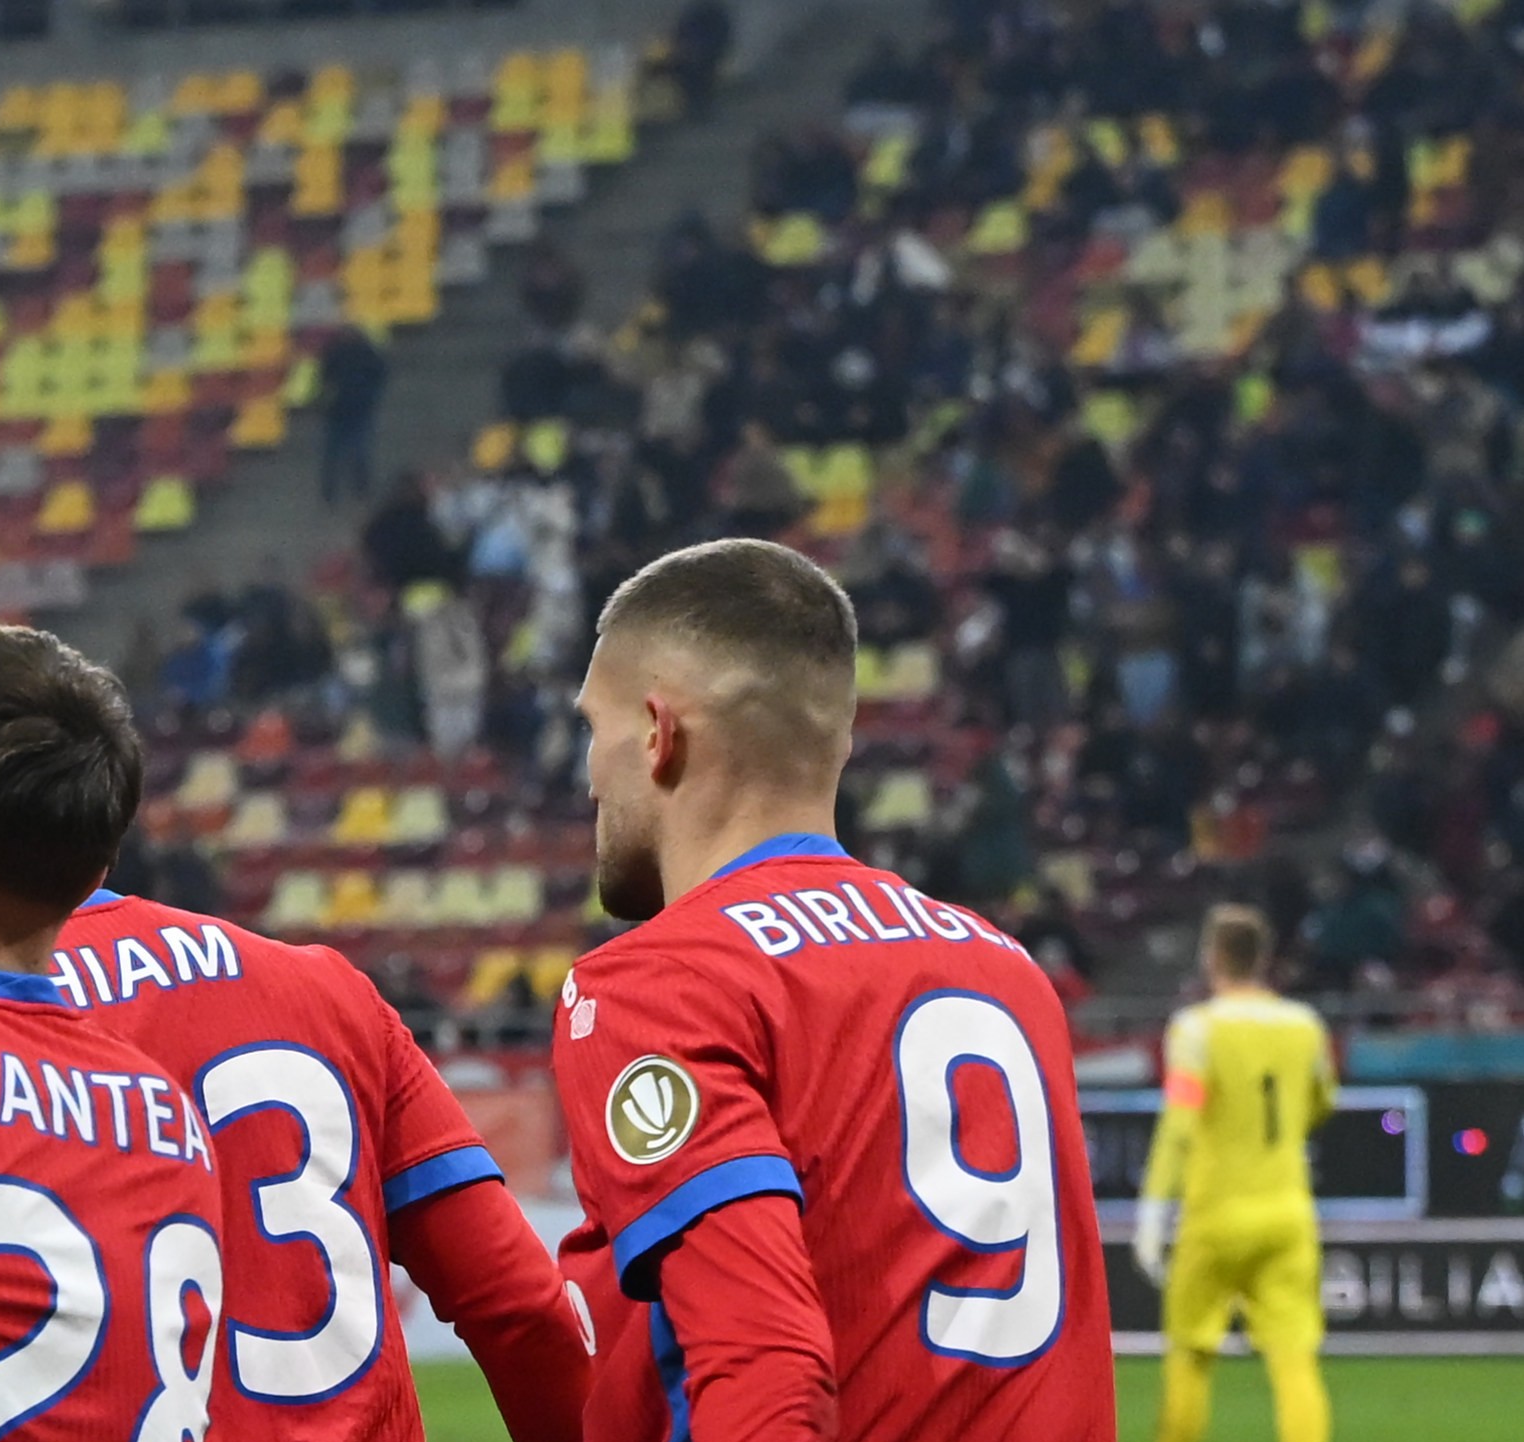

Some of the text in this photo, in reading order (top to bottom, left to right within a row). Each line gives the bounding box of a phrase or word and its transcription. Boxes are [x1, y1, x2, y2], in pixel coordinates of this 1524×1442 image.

[720, 882, 1034, 956] BIRLIG
[892, 988, 1065, 1367] 9
[1260, 1072, 1280, 1147] 1
[194, 1040, 382, 1402] 3
